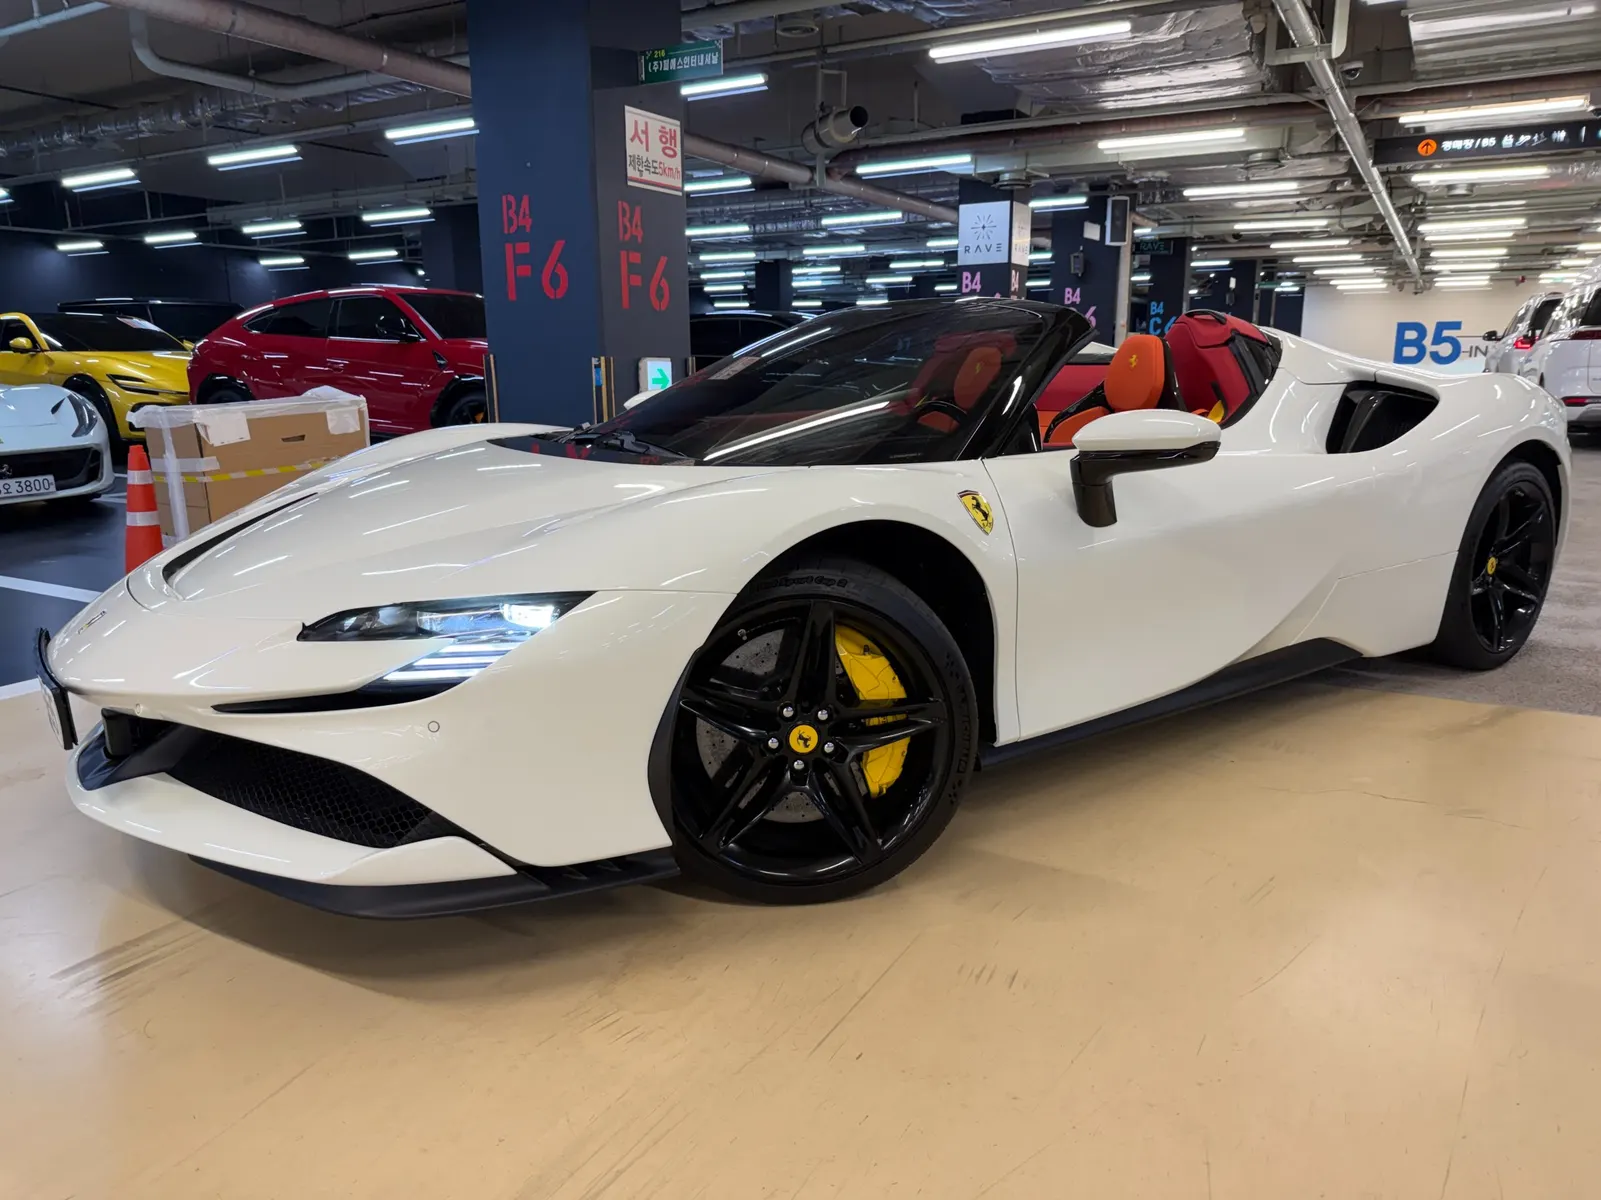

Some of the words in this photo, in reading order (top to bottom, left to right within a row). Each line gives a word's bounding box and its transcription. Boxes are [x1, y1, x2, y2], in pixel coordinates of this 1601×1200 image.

[502, 194, 532, 234] B4
[618, 200, 643, 244] B4
[964, 243, 1002, 254] RAVE
[962, 271, 981, 293] B4
[1011, 269, 1020, 292] B4
[1064, 288, 1081, 304] B4
[1150, 301, 1164, 315] B4
[1149, 316, 1162, 335] C
[15, 478, 50, 493] 3800
